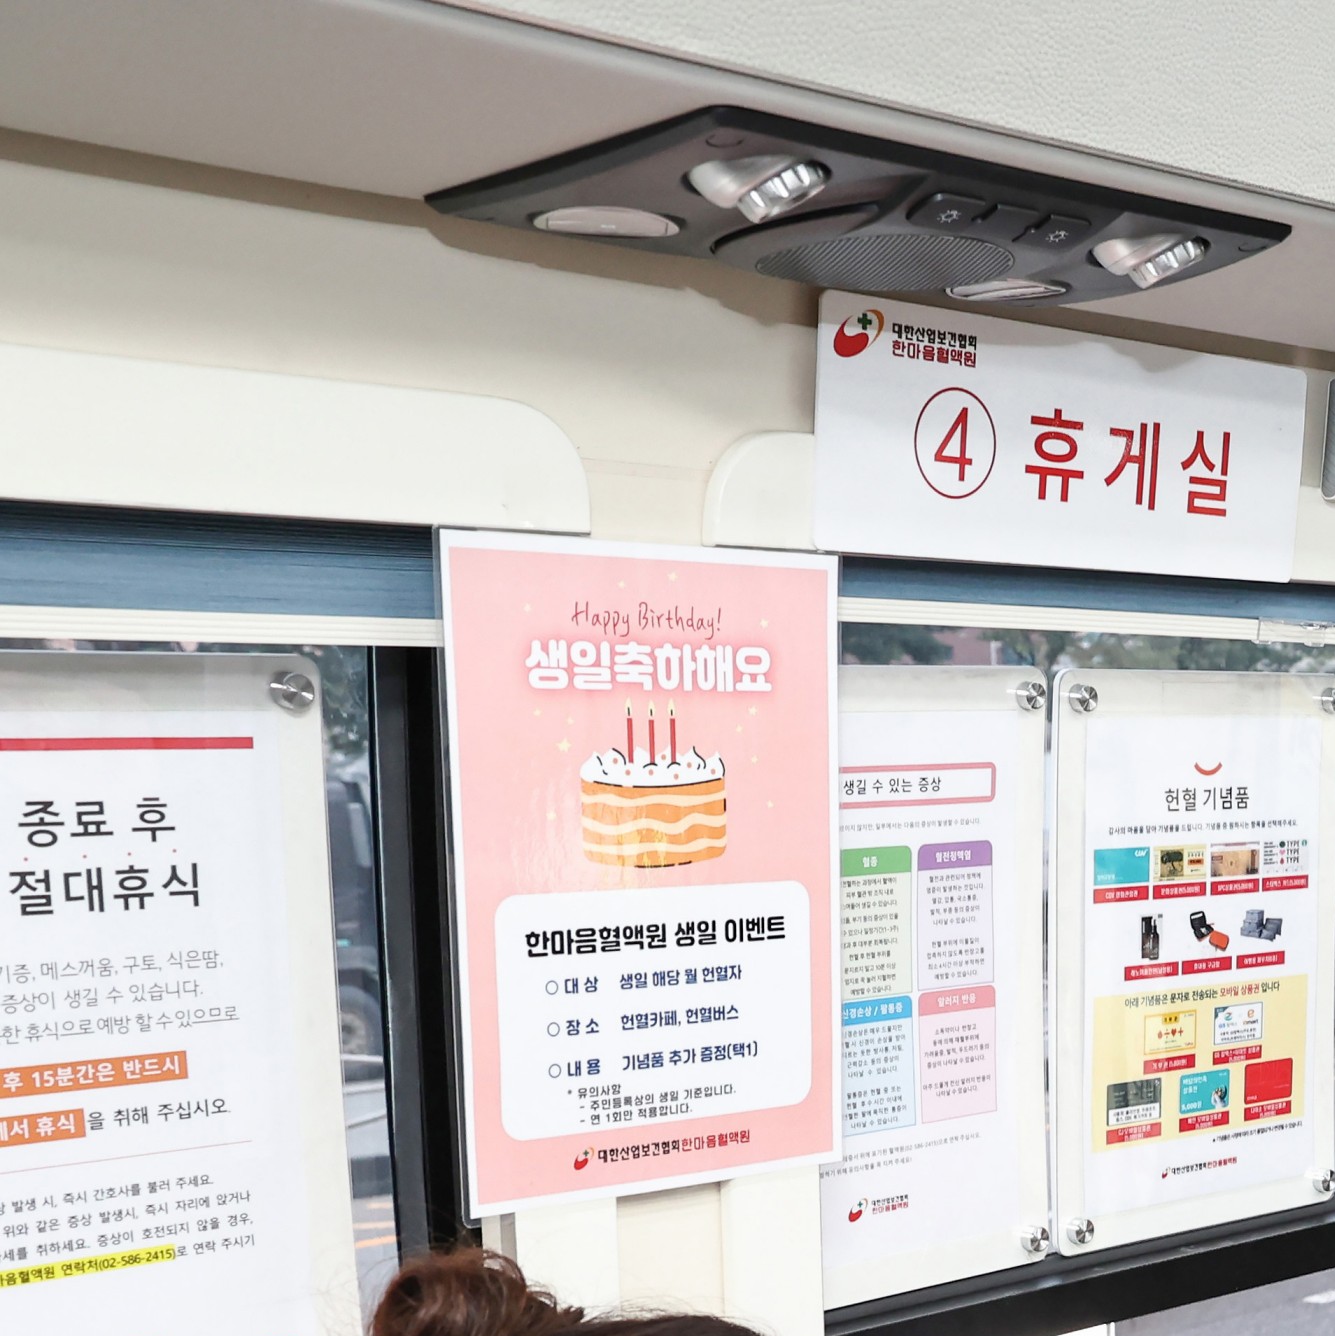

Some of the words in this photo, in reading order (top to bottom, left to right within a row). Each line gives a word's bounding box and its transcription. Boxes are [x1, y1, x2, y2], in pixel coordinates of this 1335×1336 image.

[891, 339, 978, 369] 한마음혈액원
[892, 322, 978, 352] 대한산업보건협회
[1024, 407, 1233, 518] 휴게실
[572, 601, 630, 636] Happy
[637, 602, 722, 639] Birthday!
[525, 639, 772, 692] 생일축하해요
[844, 779, 867, 796] 생길
[872, 779, 883, 794] 수
[889, 778, 913, 794] 있는
[918, 776, 942, 793] 증상
[1164, 787, 1197, 812] 헌혈
[1202, 786, 1250, 811] 기념품
[18, 800, 114, 848] 종료
[131, 797, 176, 842] 후
[9, 862, 200, 916] 절대휴식
[524, 923, 668, 958] 한마음혈액원
[674, 919, 718, 947] 생일
[724, 915, 786, 943] 이벤트
[40, 957, 119, 981] 메스꺼움,
[123, 955, 163, 974] 구토,
[166, 949, 224, 970] 식은땀,
[619, 972, 649, 991] 생일
[652, 969, 681, 988] 해당
[684, 968, 699, 985] 월
[702, 965, 743, 984] 헌혈자
[1, 991, 56, 1015] 증상이
[63, 988, 99, 1009] 생길
[106, 987, 124, 1004] 수
[129, 979, 204, 1003] 있습니다.
[1125, 998, 1139, 1009] 아래
[25, 1018, 96, 1043] 휴식으로
[96, 1014, 132, 1036] 예방
[136, 1013, 152, 1032] 할
[156, 1011, 174, 1028] 수
[175, 1005, 241, 1028] 있으므로
[621, 1008, 683, 1032] 헌혈카페,
[686, 1004, 740, 1025] 헌혈버스
[622, 1053, 665, 1072] 기념품
[668, 1048, 697, 1066] 추가
[700, 1040, 760, 1063] 증정(택1)
[3, 1071, 24, 1093] 후
[32, 1062, 116, 1089] 15분간은
[122, 1055, 181, 1079] 반드시
[577, 1084, 622, 1100] 유의사항
[590, 1092, 655, 1112] 주민등록상의
[659, 1089, 679, 1105] 생일
[683, 1083, 737, 1101] 기준입니다.
[36, 1112, 76, 1137] 휴식
[113, 1105, 150, 1127] 취해
[157, 1098, 231, 1121] 주십시오.
[590, 1112, 601, 1125] 연
[11, 1197, 37, 1214] 발생
[42, 1194, 58, 1209] 시,
[62, 1190, 88, 1205] 즉시
[93, 1183, 142, 1202] 간호사를
[147, 1178, 171, 1194] 불러
[175, 1174, 214, 1190] 주세요.
[3, 1222, 29, 1238] 위와
[36, 1218, 61, 1234] 같은
[67, 1213, 92, 1229] 증상
[145, 1201, 169, 1216] 즉시
[175, 1195, 211, 1212] 자리에
[216, 1189, 251, 1207] 앉거나
[0, 1246, 28, 1262] 세를
[36, 1238, 91, 1257] 취하세요.
[97, 1230, 135, 1248] 증상이
[141, 1221, 190, 1240] 호전되지
[196, 1216, 221, 1233] 않을
[192, 1239, 217, 1256] 연락
[220, 1233, 256, 1251] 주시기
